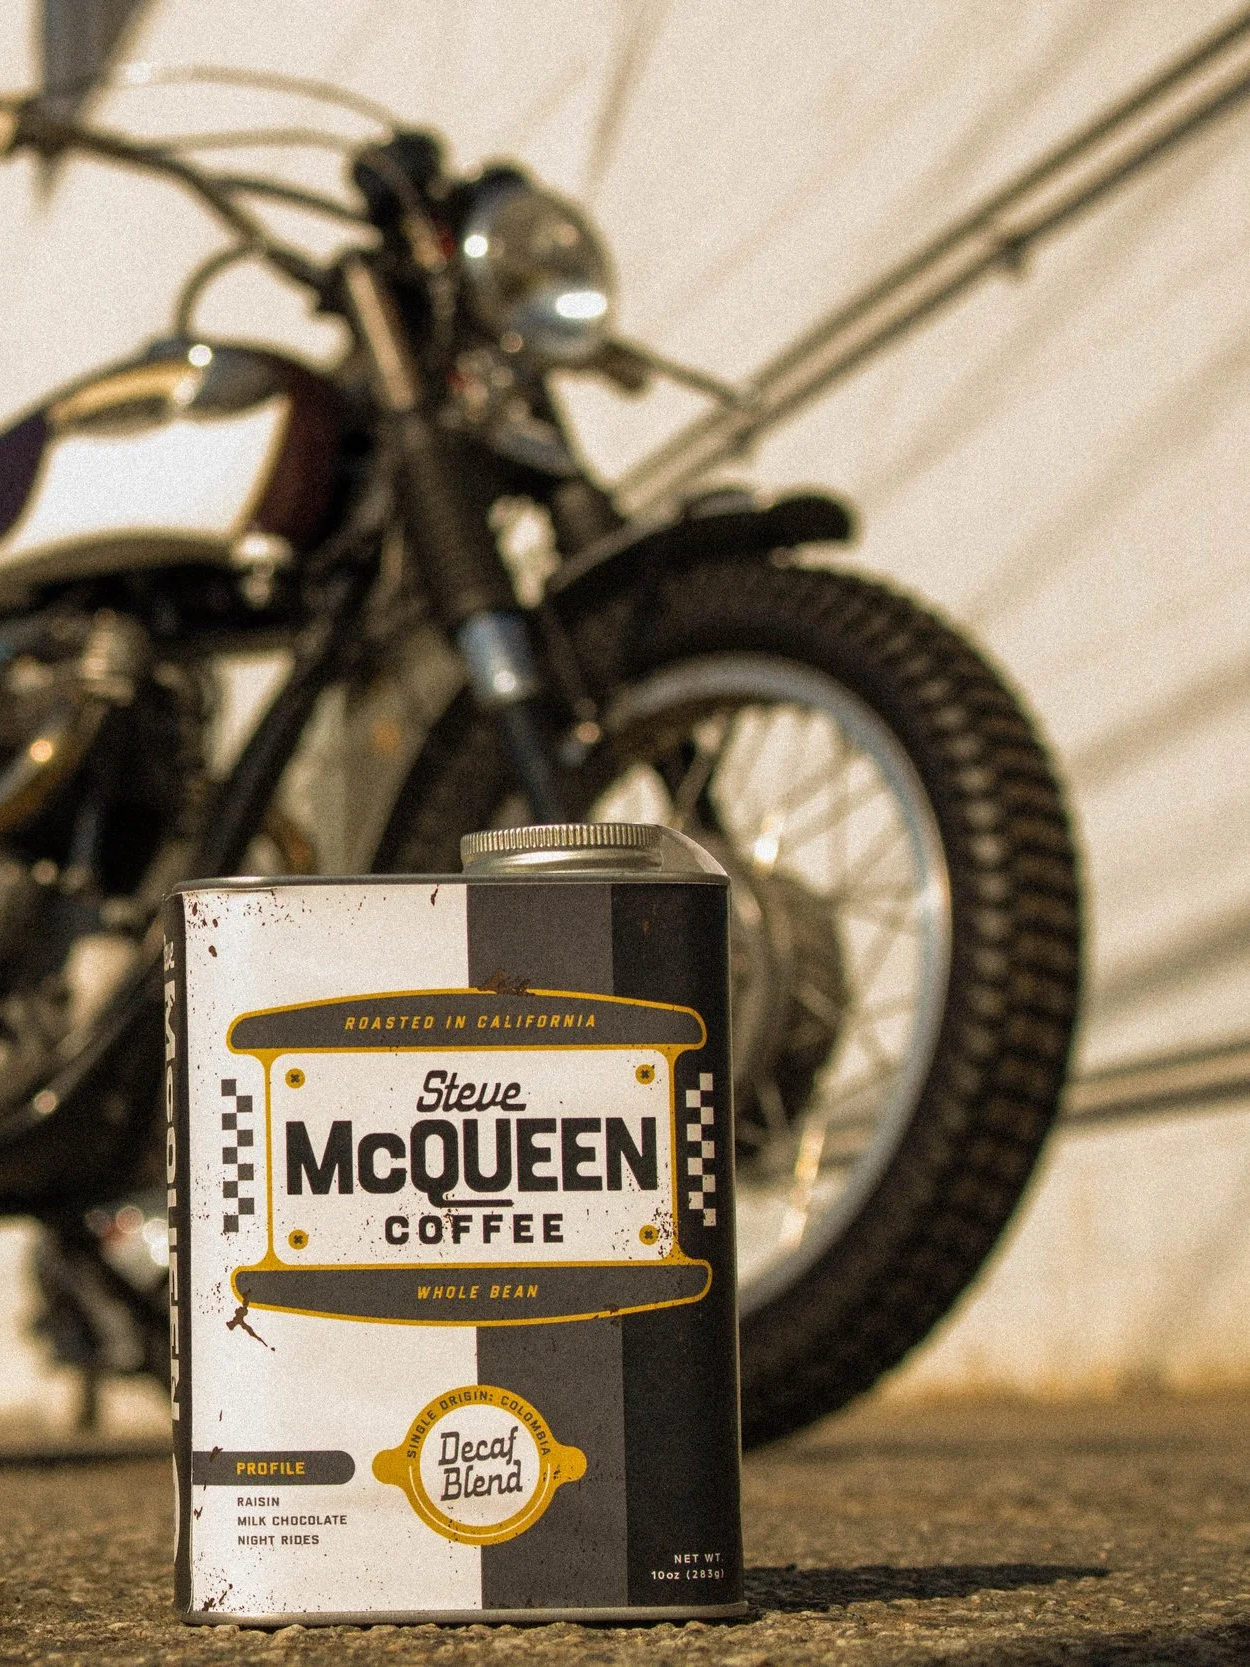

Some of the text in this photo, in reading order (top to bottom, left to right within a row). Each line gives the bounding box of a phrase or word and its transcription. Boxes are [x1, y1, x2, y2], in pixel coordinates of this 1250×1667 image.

[345, 1014, 596, 1030] ROASTED IN CALIFORNIA
[416, 1069, 527, 1113] Steve
[285, 1116, 658, 1208] McQUEEN
[385, 1213, 564, 1245] COFFEE
[417, 1284, 539, 1300] WHOLE BEAN
[407, 1391, 551, 1459] SINGLE ORIGIN: COLOMBIA
[438, 1426, 519, 1466] Decaf
[236, 1462, 305, 1476] PROFILE
[440, 1459, 524, 1502] Blend
[237, 1497, 280, 1507] RAISIN
[237, 1515, 348, 1526] MILK CHOCOLATE
[238, 1535, 319, 1545] NIGHT RIDES
[674, 1553, 724, 1564] NET WT.
[651, 1569, 724, 1580] 10oz (283g)
